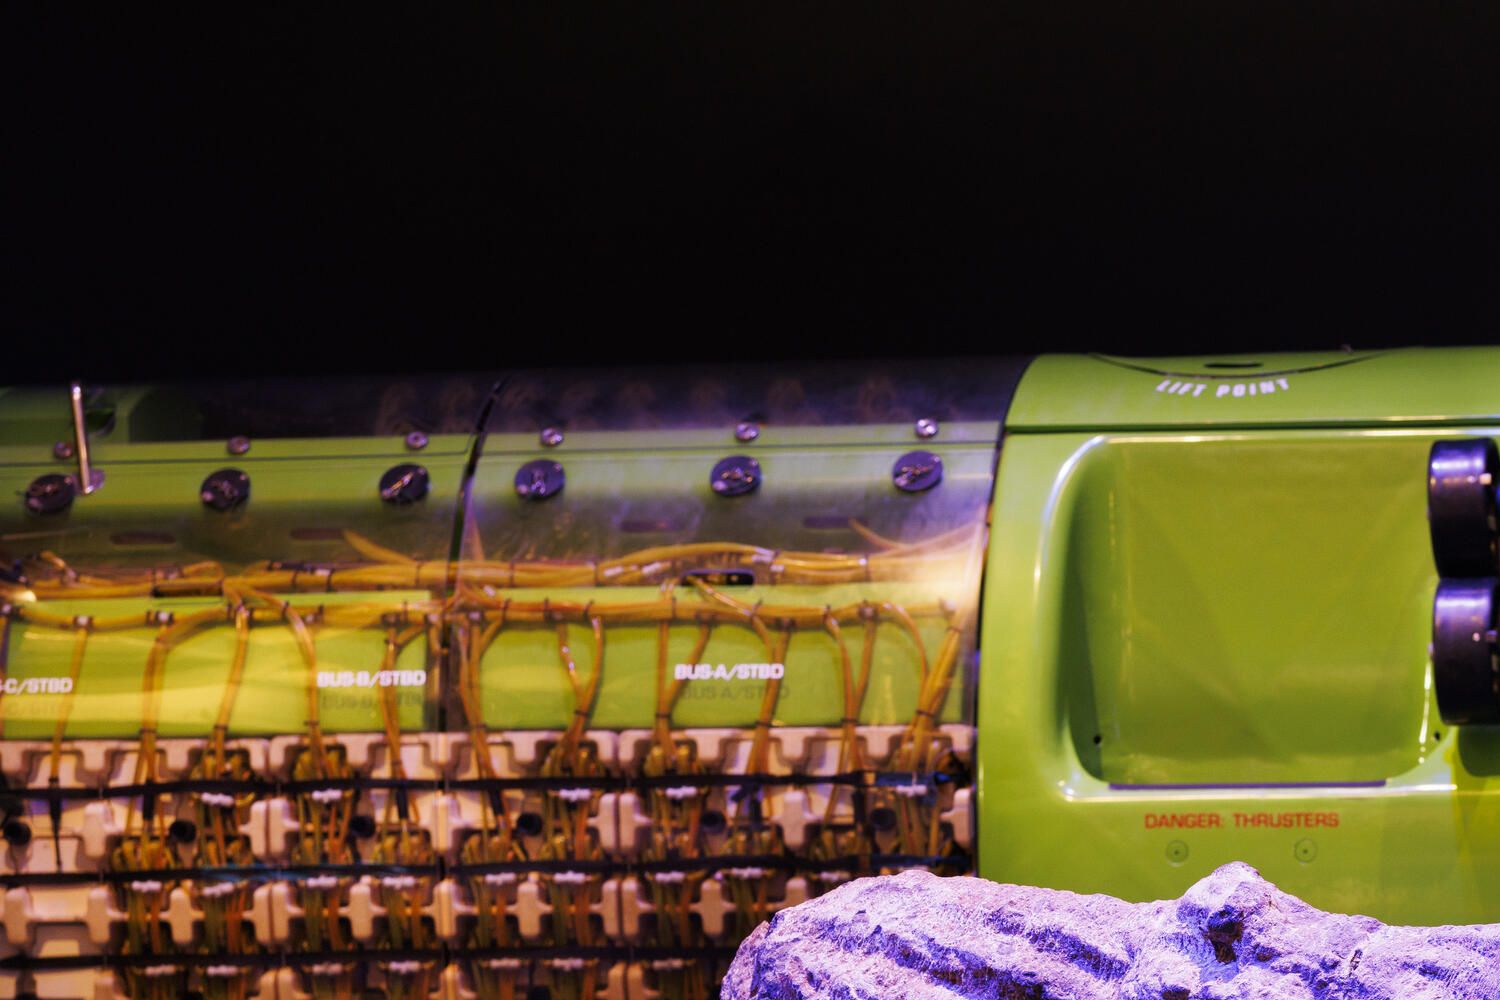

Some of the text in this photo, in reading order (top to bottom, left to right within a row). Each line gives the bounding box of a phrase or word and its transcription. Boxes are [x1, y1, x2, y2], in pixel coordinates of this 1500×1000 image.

[1156, 378, 1289, 398] LIFT POINT
[1232, 812, 1340, 829] THRUSTERS
